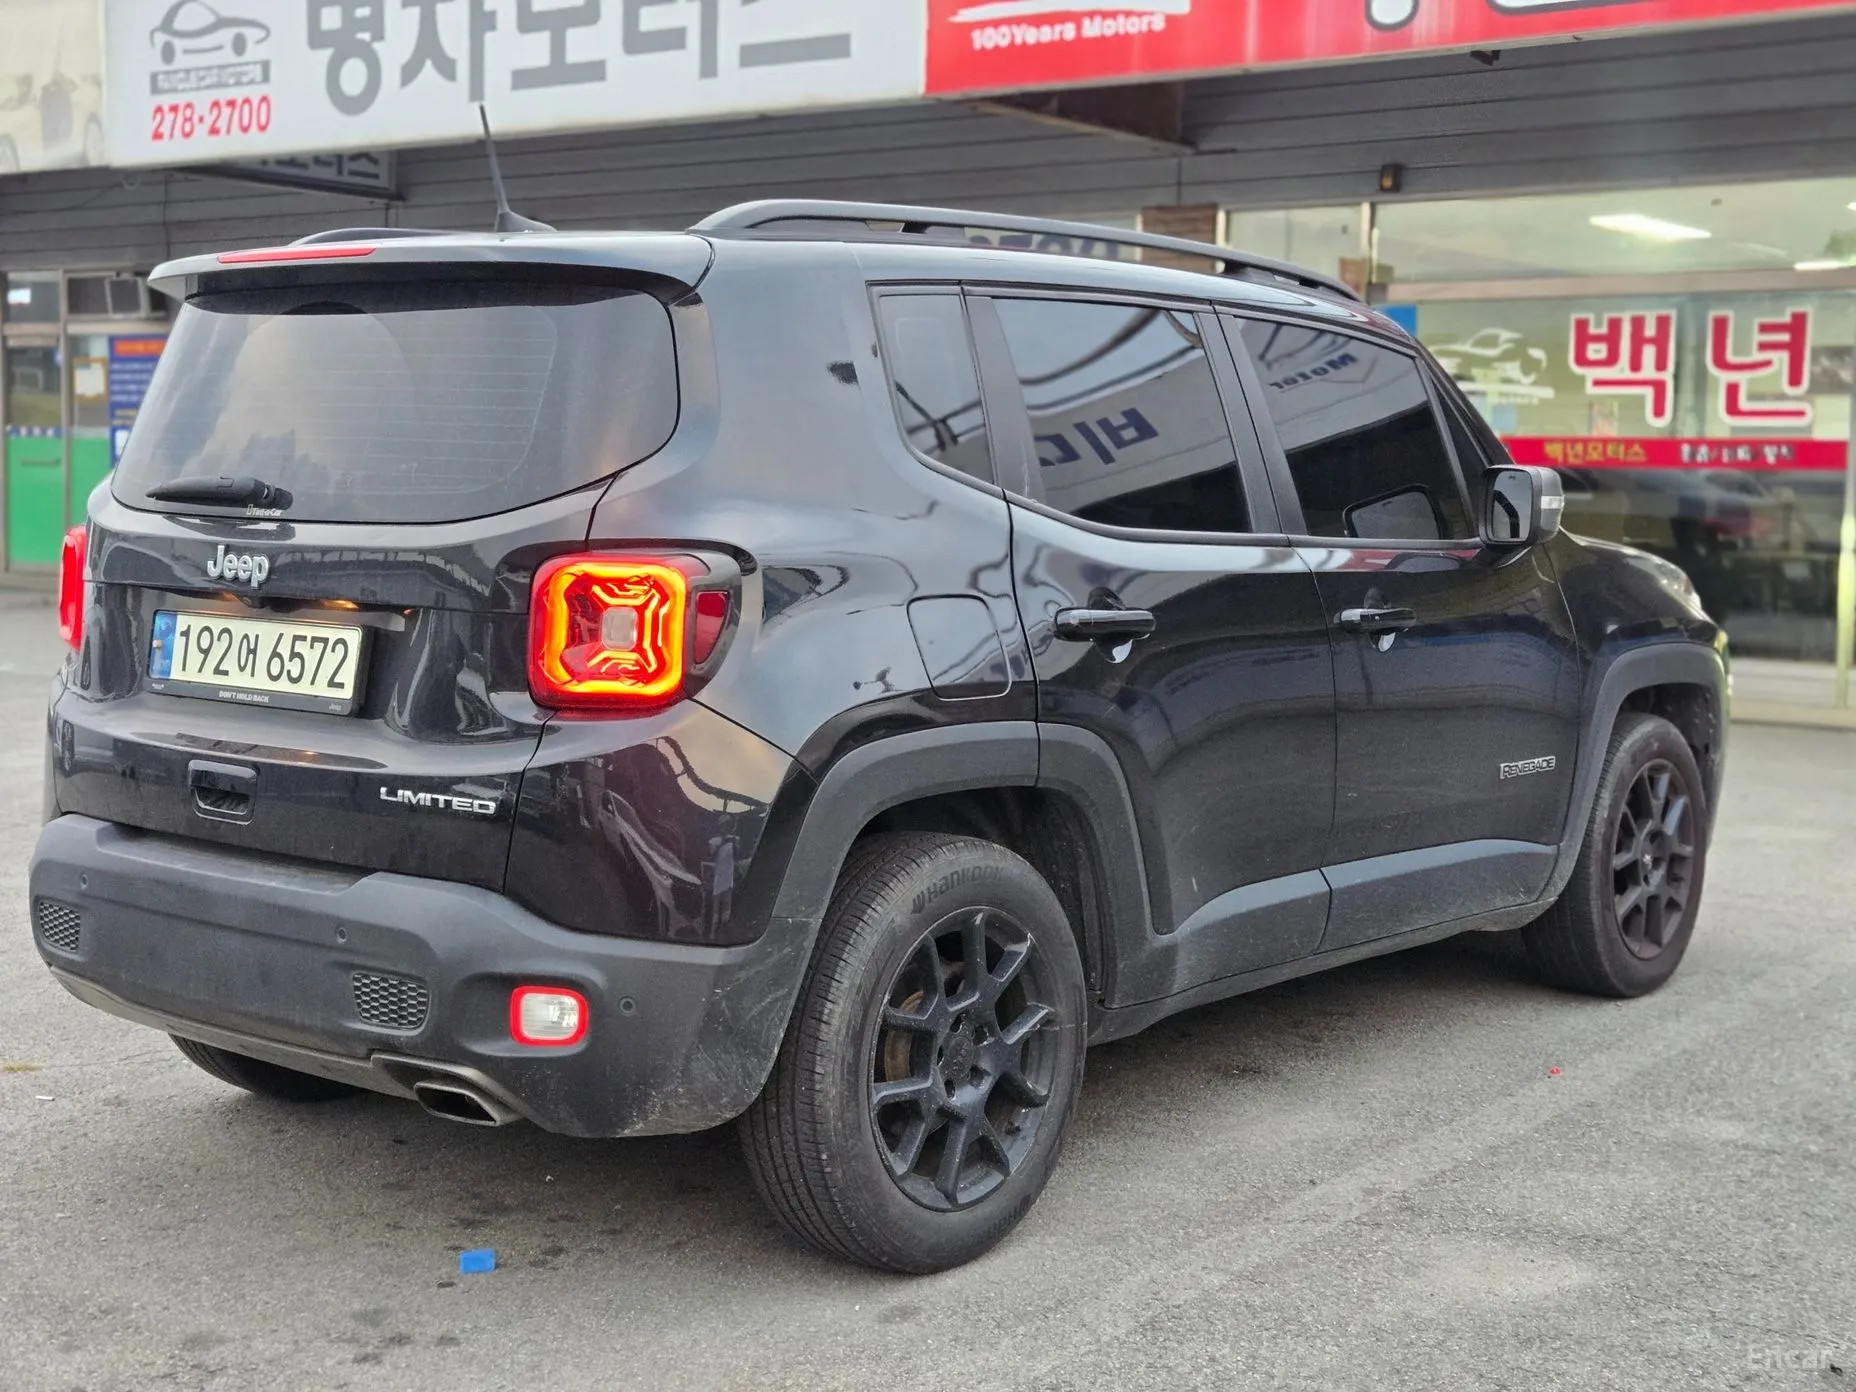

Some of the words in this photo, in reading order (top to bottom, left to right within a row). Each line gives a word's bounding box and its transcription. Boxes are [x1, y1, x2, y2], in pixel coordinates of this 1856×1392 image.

[1081, 13, 1166, 38] Motors
[1569, 306, 1812, 427] 백년
[206, 544, 270, 588] Jeep
[266, 631, 349, 689] 6572
[1500, 756, 1556, 779] RENEGADE
[380, 786, 497, 815] LIMITED
